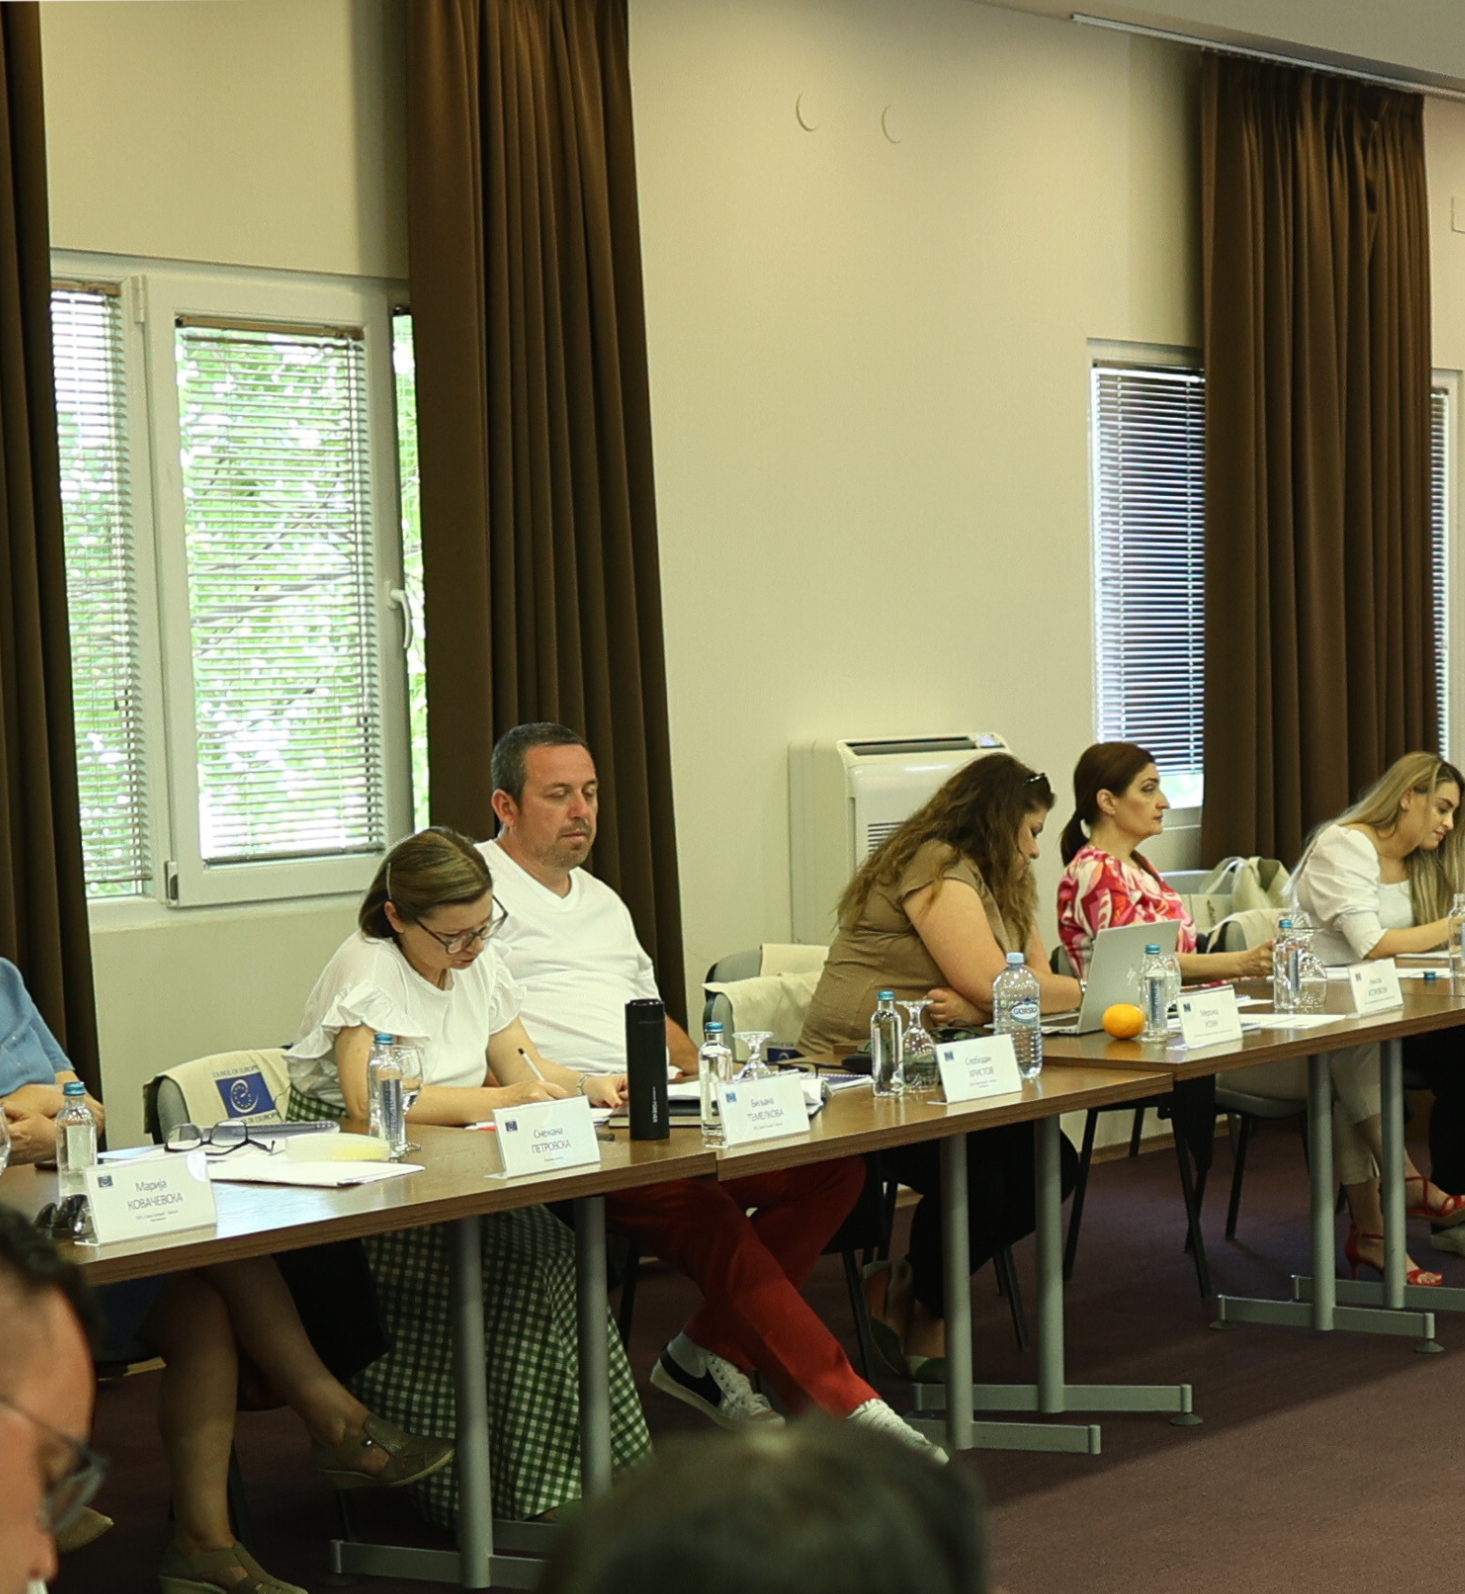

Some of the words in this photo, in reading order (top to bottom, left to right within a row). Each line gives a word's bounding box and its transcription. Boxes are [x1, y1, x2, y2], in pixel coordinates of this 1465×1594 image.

[747, 1108, 785, 1122] ТЕМЕЛКОВА
[531, 1139, 572, 1154] ПЕТРОВСКА
[135, 1178, 168, 1193] Марија
[127, 1192, 184, 1211] КОВАЧЕВСКА
